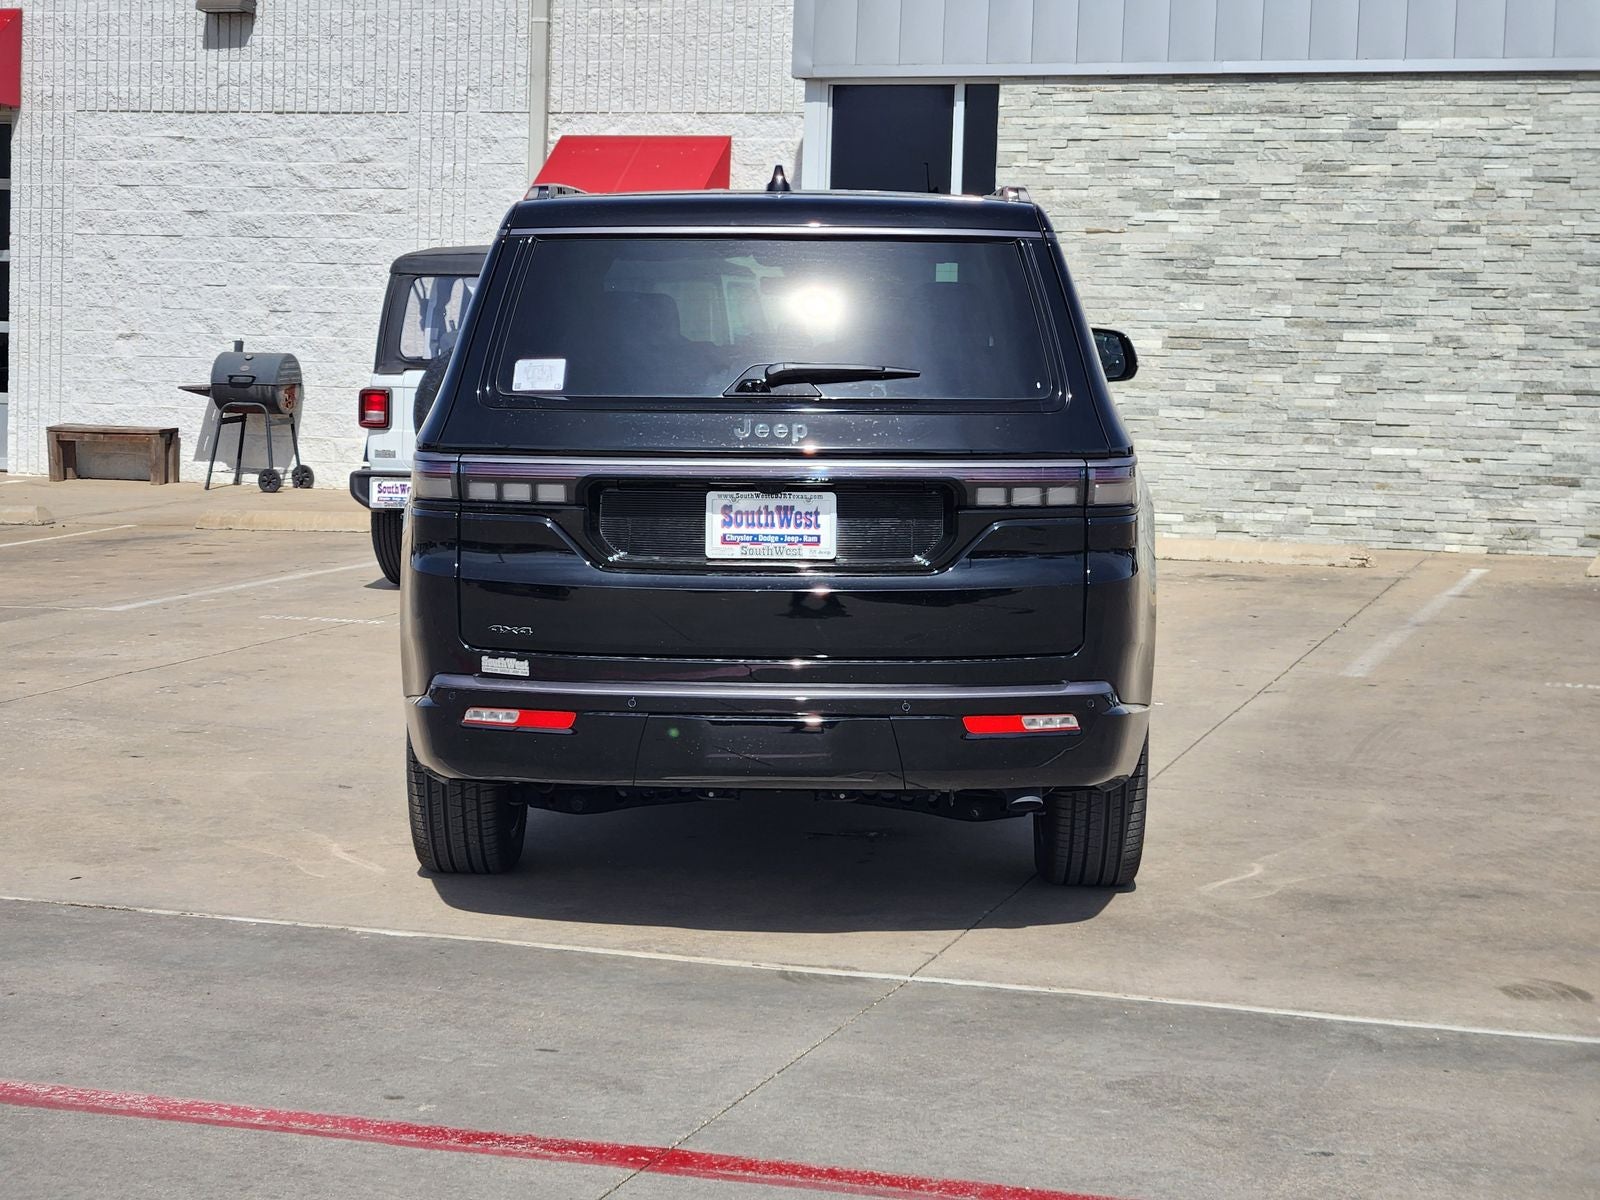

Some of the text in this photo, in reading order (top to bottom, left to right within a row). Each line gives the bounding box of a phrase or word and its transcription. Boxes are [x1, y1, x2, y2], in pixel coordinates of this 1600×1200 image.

[733, 419, 808, 444] Jeep
[720, 504, 821, 529] SouthWest
[725, 534, 753, 543] Chrysler
[758, 535, 779, 543] Dodge
[783, 536, 799, 544] Jeep
